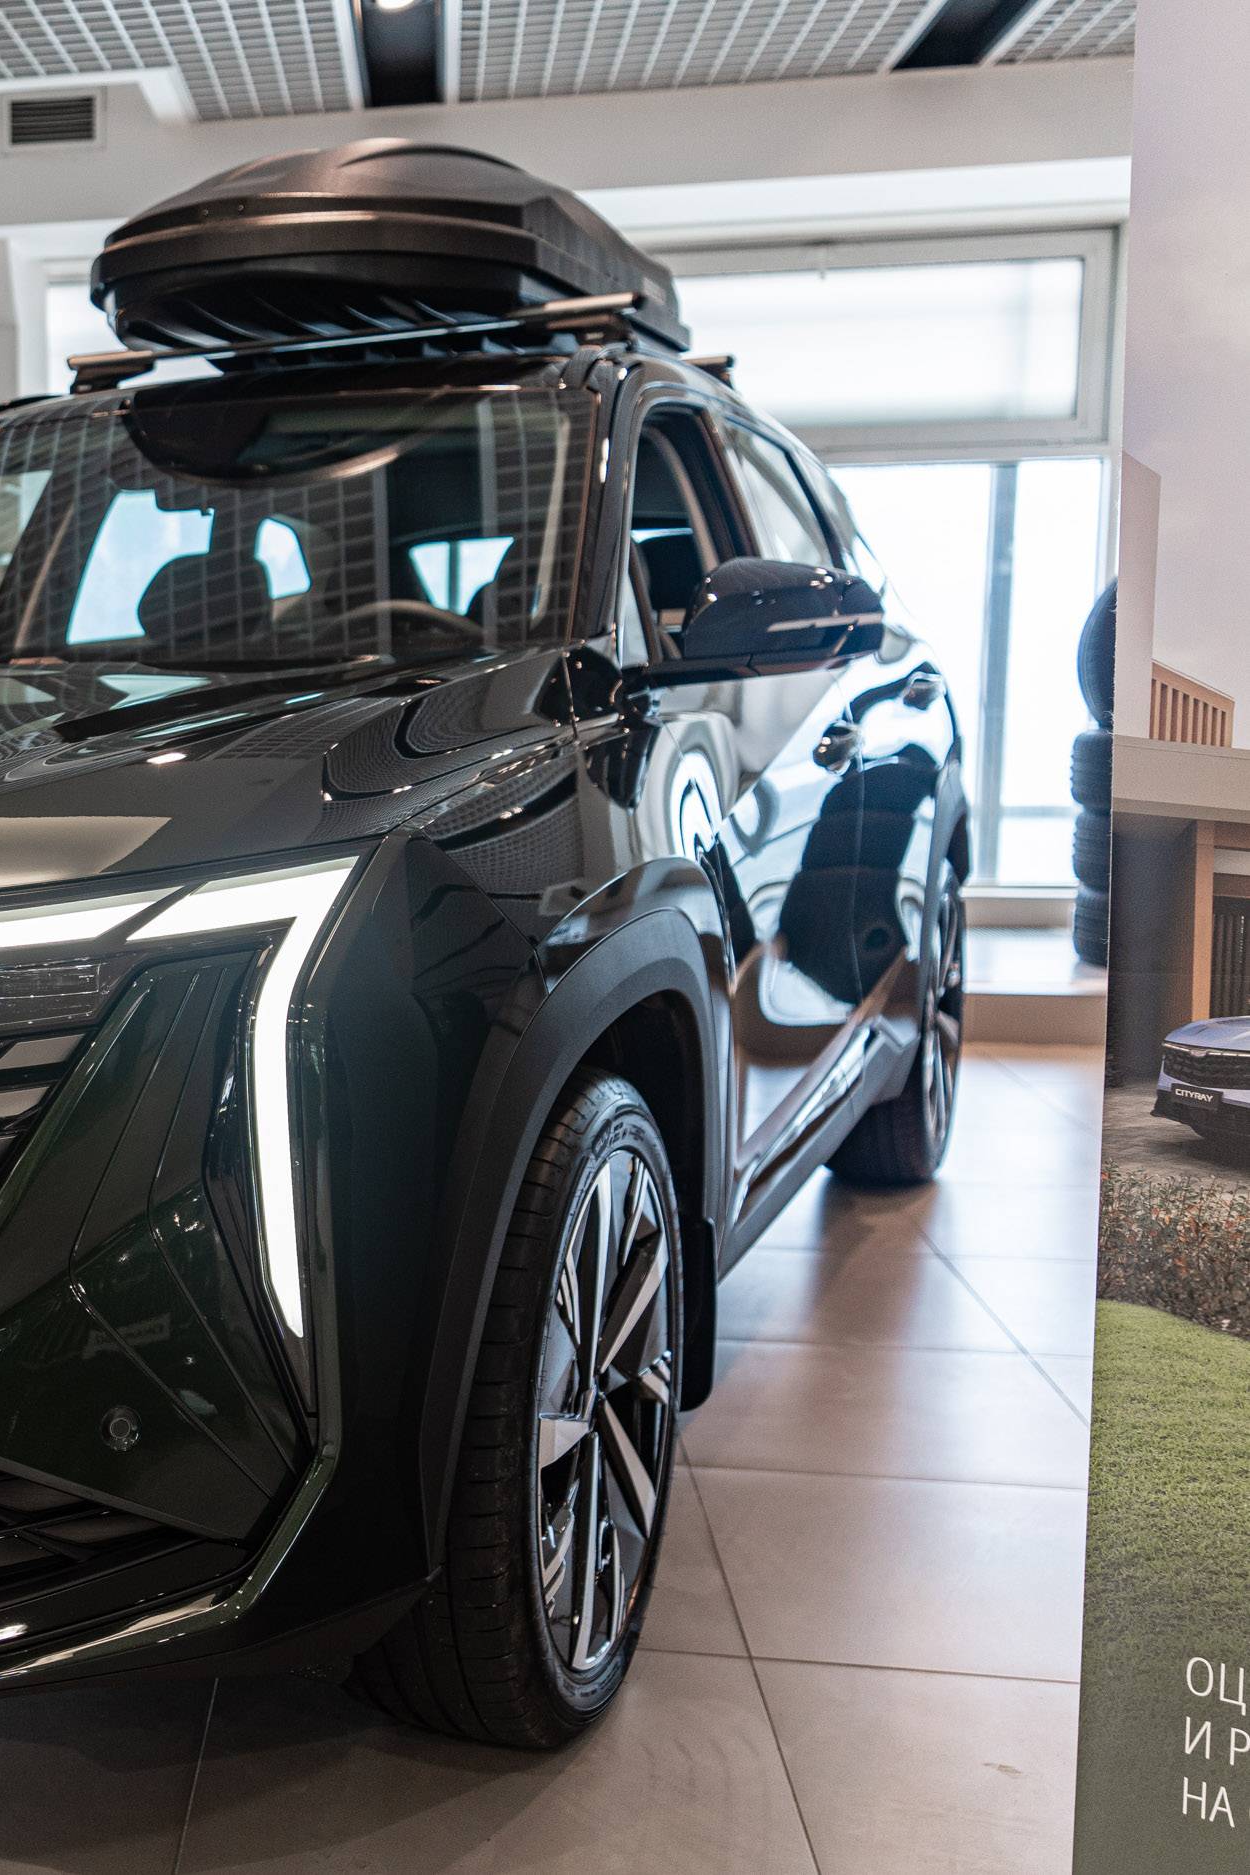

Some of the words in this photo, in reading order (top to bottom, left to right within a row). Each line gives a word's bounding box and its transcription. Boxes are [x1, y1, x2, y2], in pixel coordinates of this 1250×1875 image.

[1175, 1088, 1214, 1103] CITYRAY
[1186, 1656, 1246, 1717] ОЦ
[1184, 1715, 1211, 1760] И
[1182, 1776, 1235, 1828] НА
